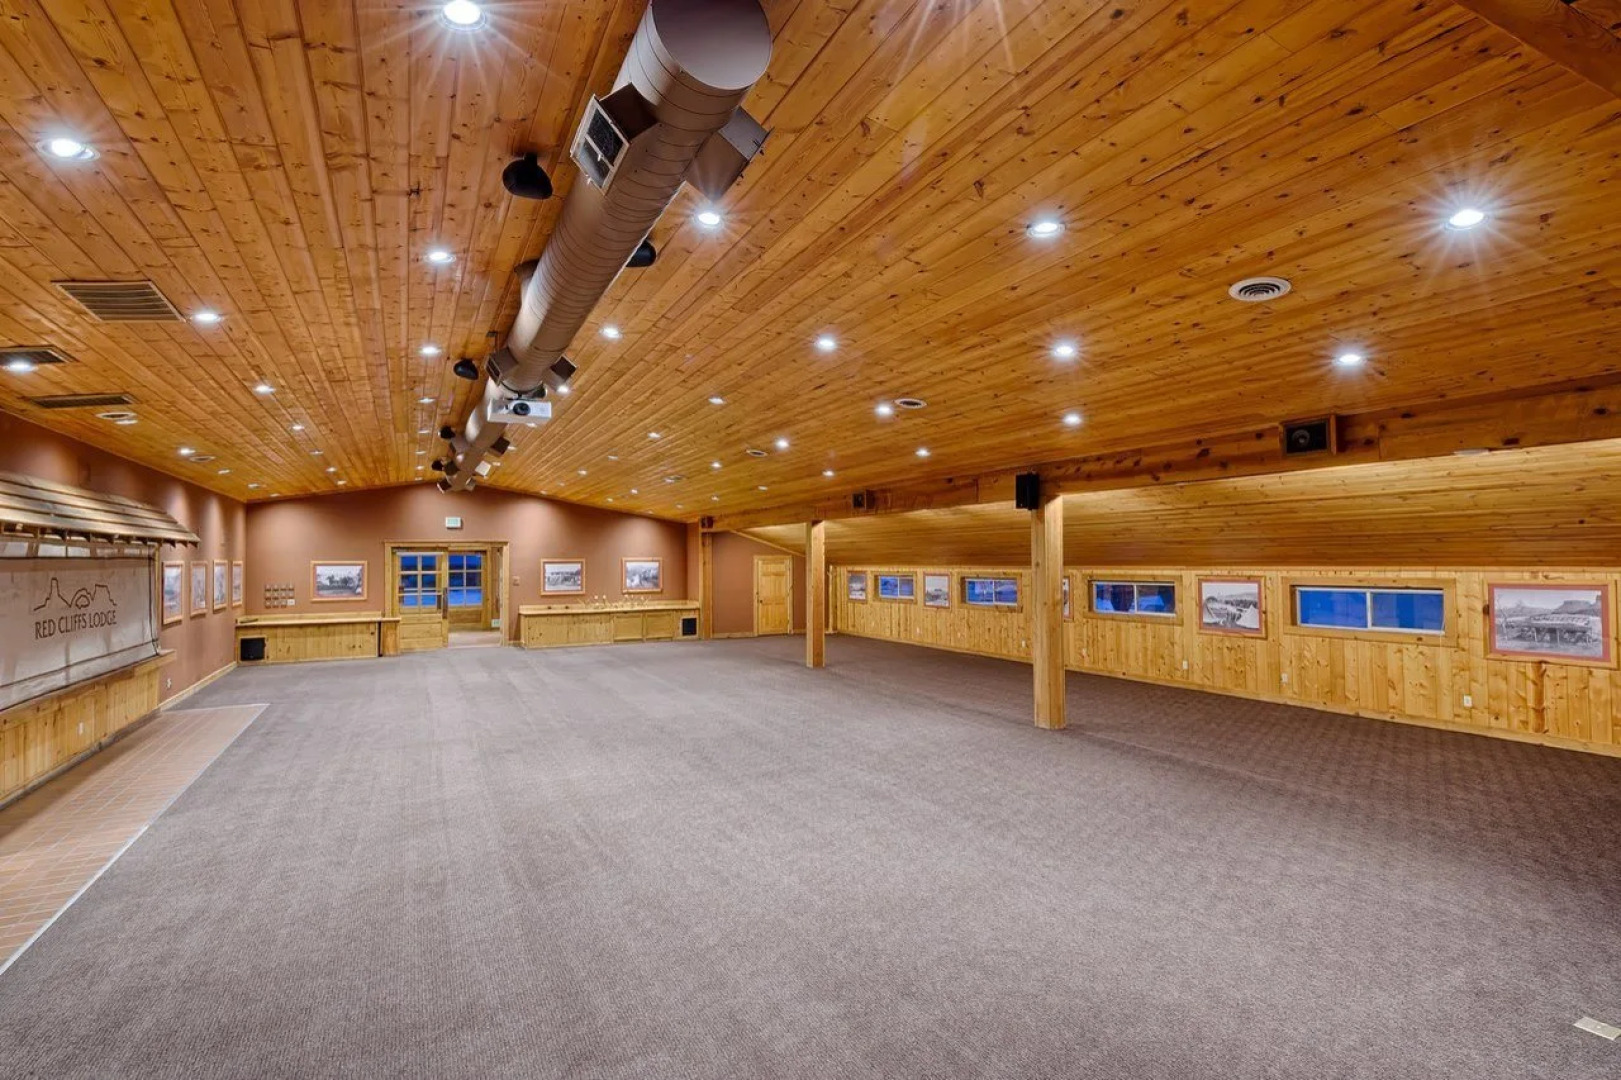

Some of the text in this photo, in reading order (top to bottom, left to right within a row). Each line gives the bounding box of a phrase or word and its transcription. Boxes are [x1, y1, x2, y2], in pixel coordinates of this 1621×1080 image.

[35, 610, 117, 639] RED CLIFFS LODGE
